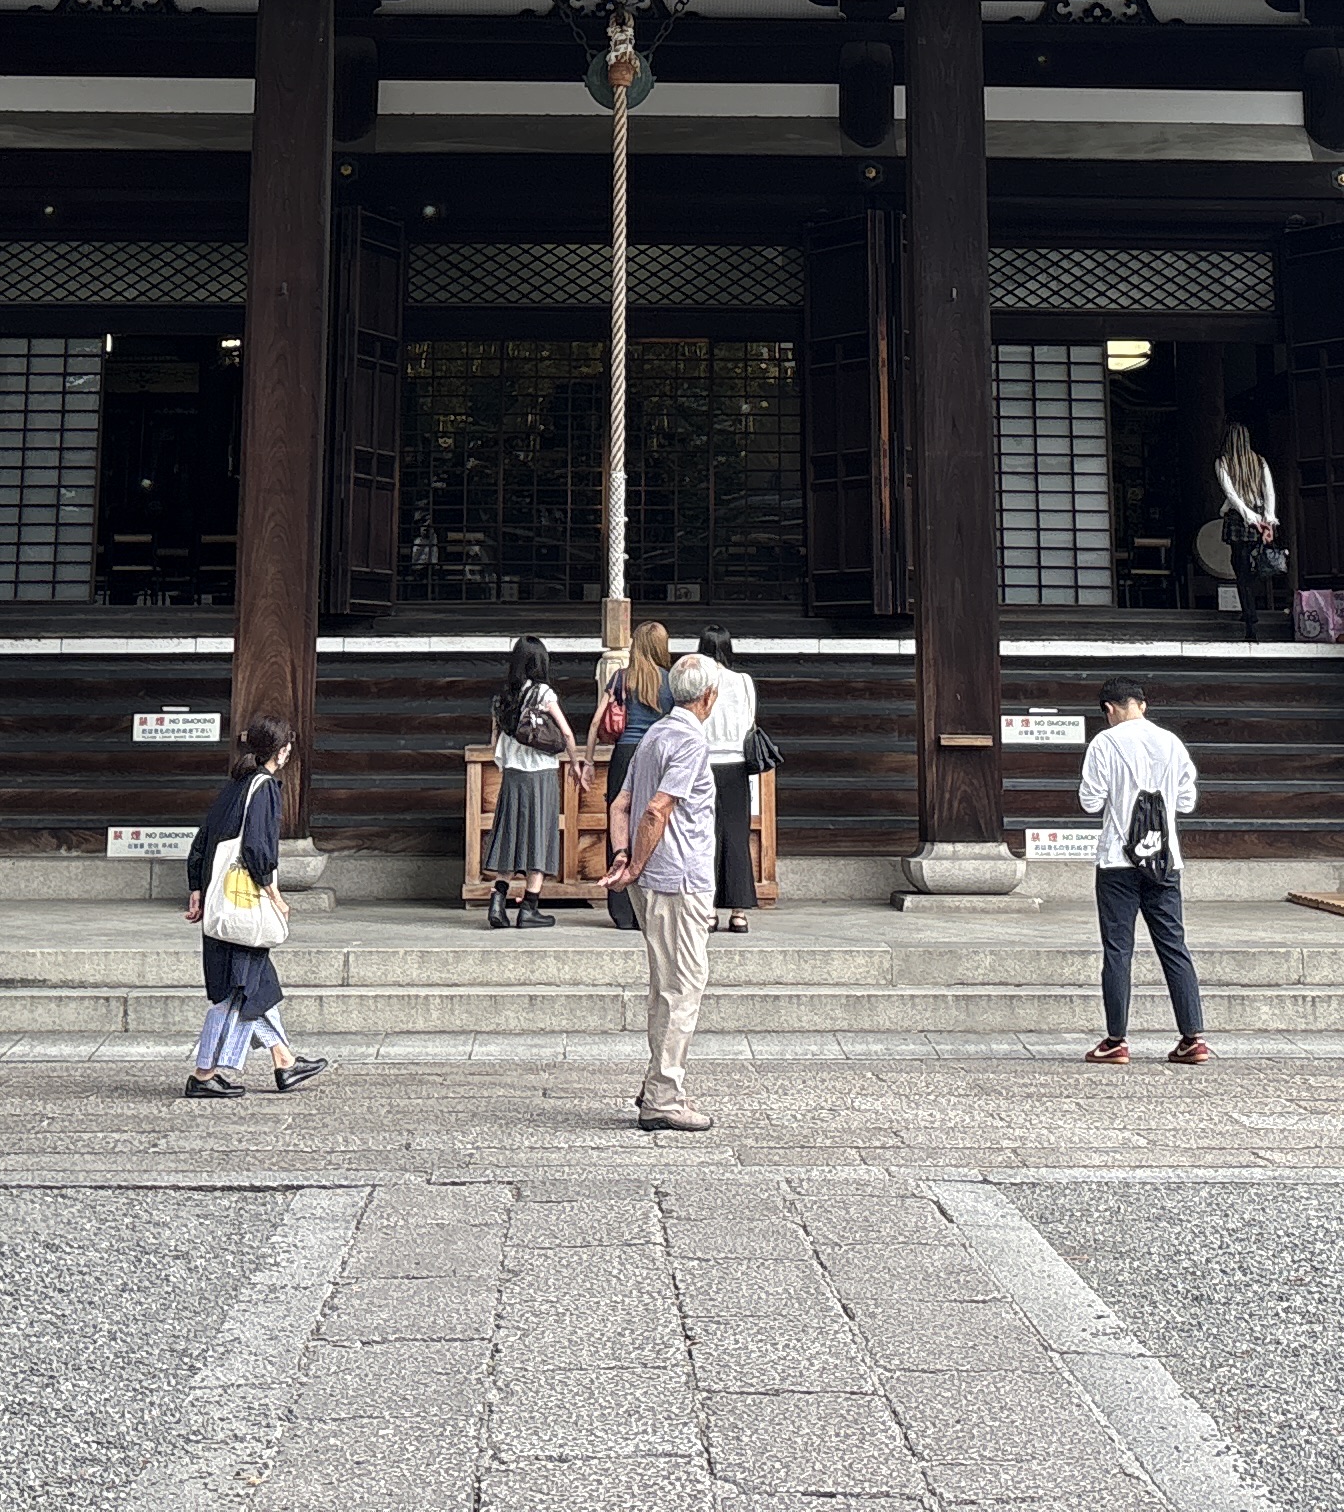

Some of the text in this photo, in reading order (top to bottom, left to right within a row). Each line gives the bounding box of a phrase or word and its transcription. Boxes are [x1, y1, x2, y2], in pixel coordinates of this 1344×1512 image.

[1034, 719, 1045, 727] NO
[1047, 719, 1079, 727] SMOKING
[1062, 833, 1073, 841] NO
